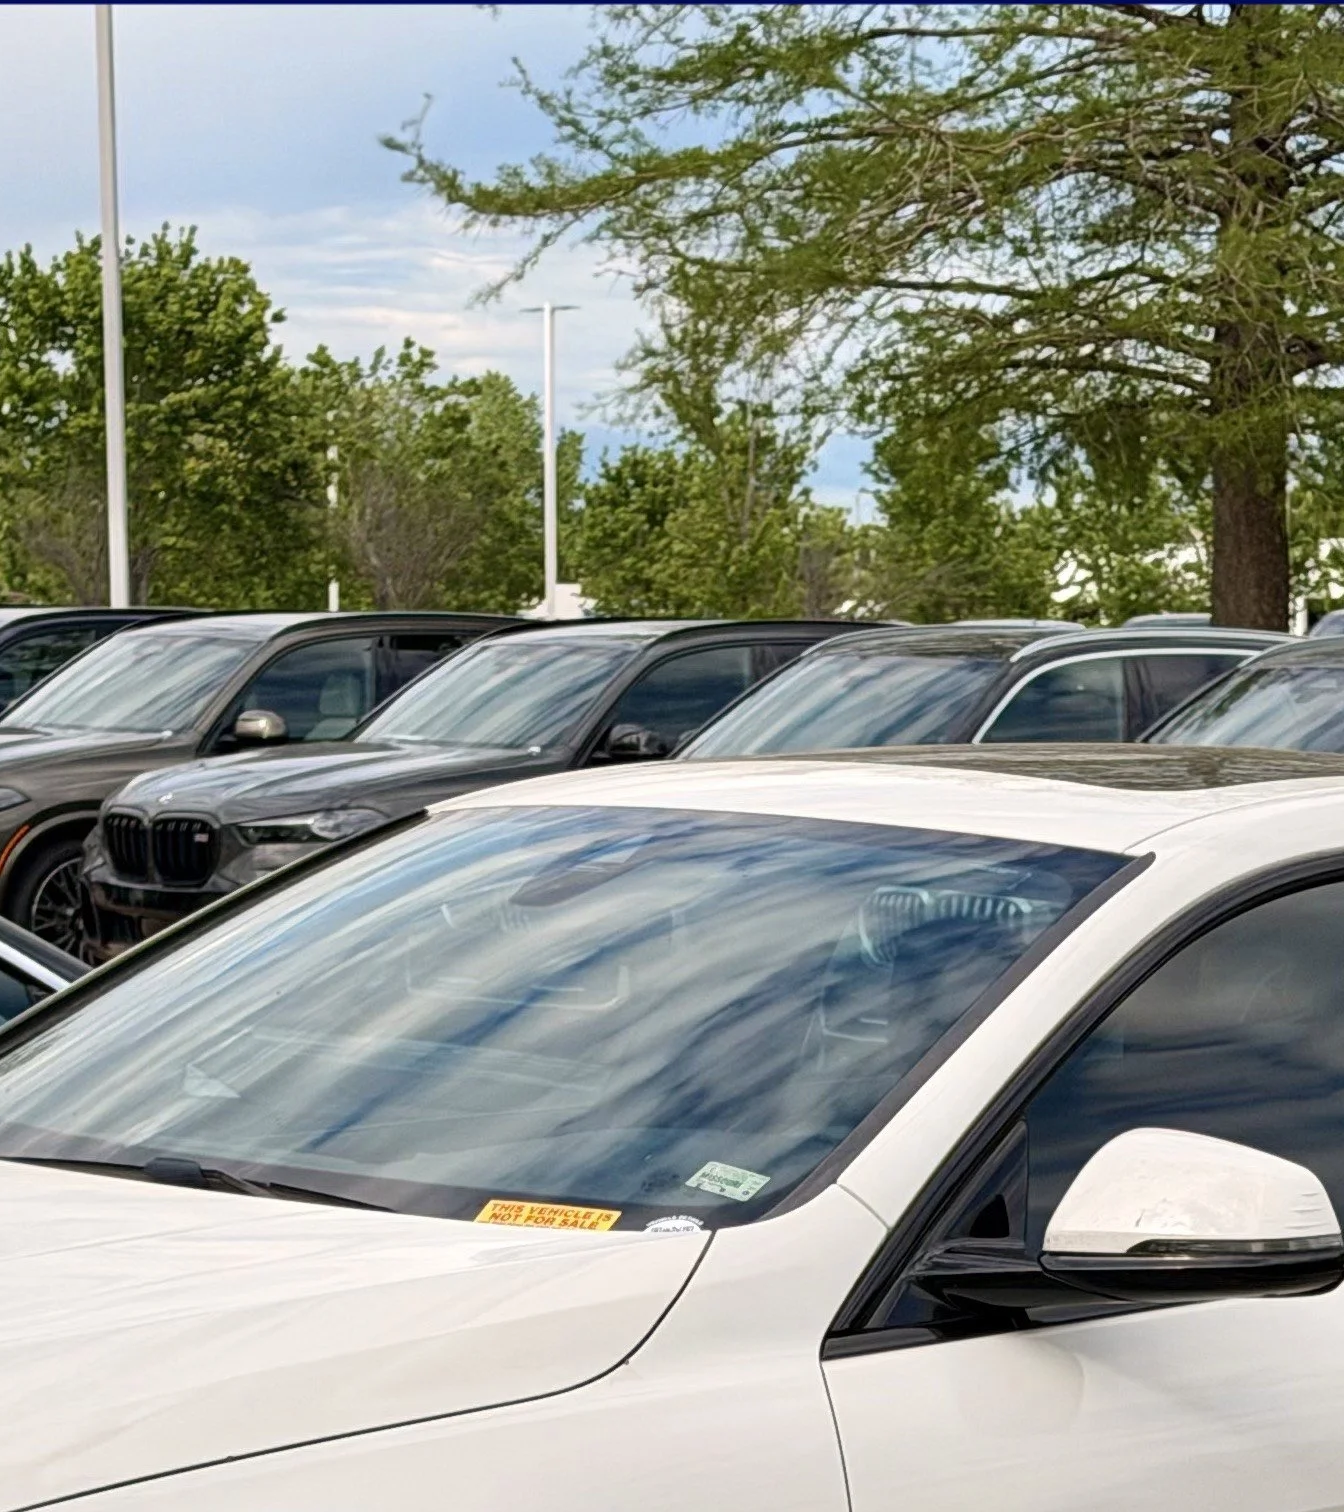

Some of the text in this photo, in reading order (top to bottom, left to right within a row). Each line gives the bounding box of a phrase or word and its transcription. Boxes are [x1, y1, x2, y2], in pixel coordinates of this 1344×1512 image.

[489, 1212, 523, 1223] NOT
[524, 1215, 556, 1225] FOR
[559, 1218, 600, 1229] SALE
[492, 1203, 614, 1222] THIS VEHICLE IS
